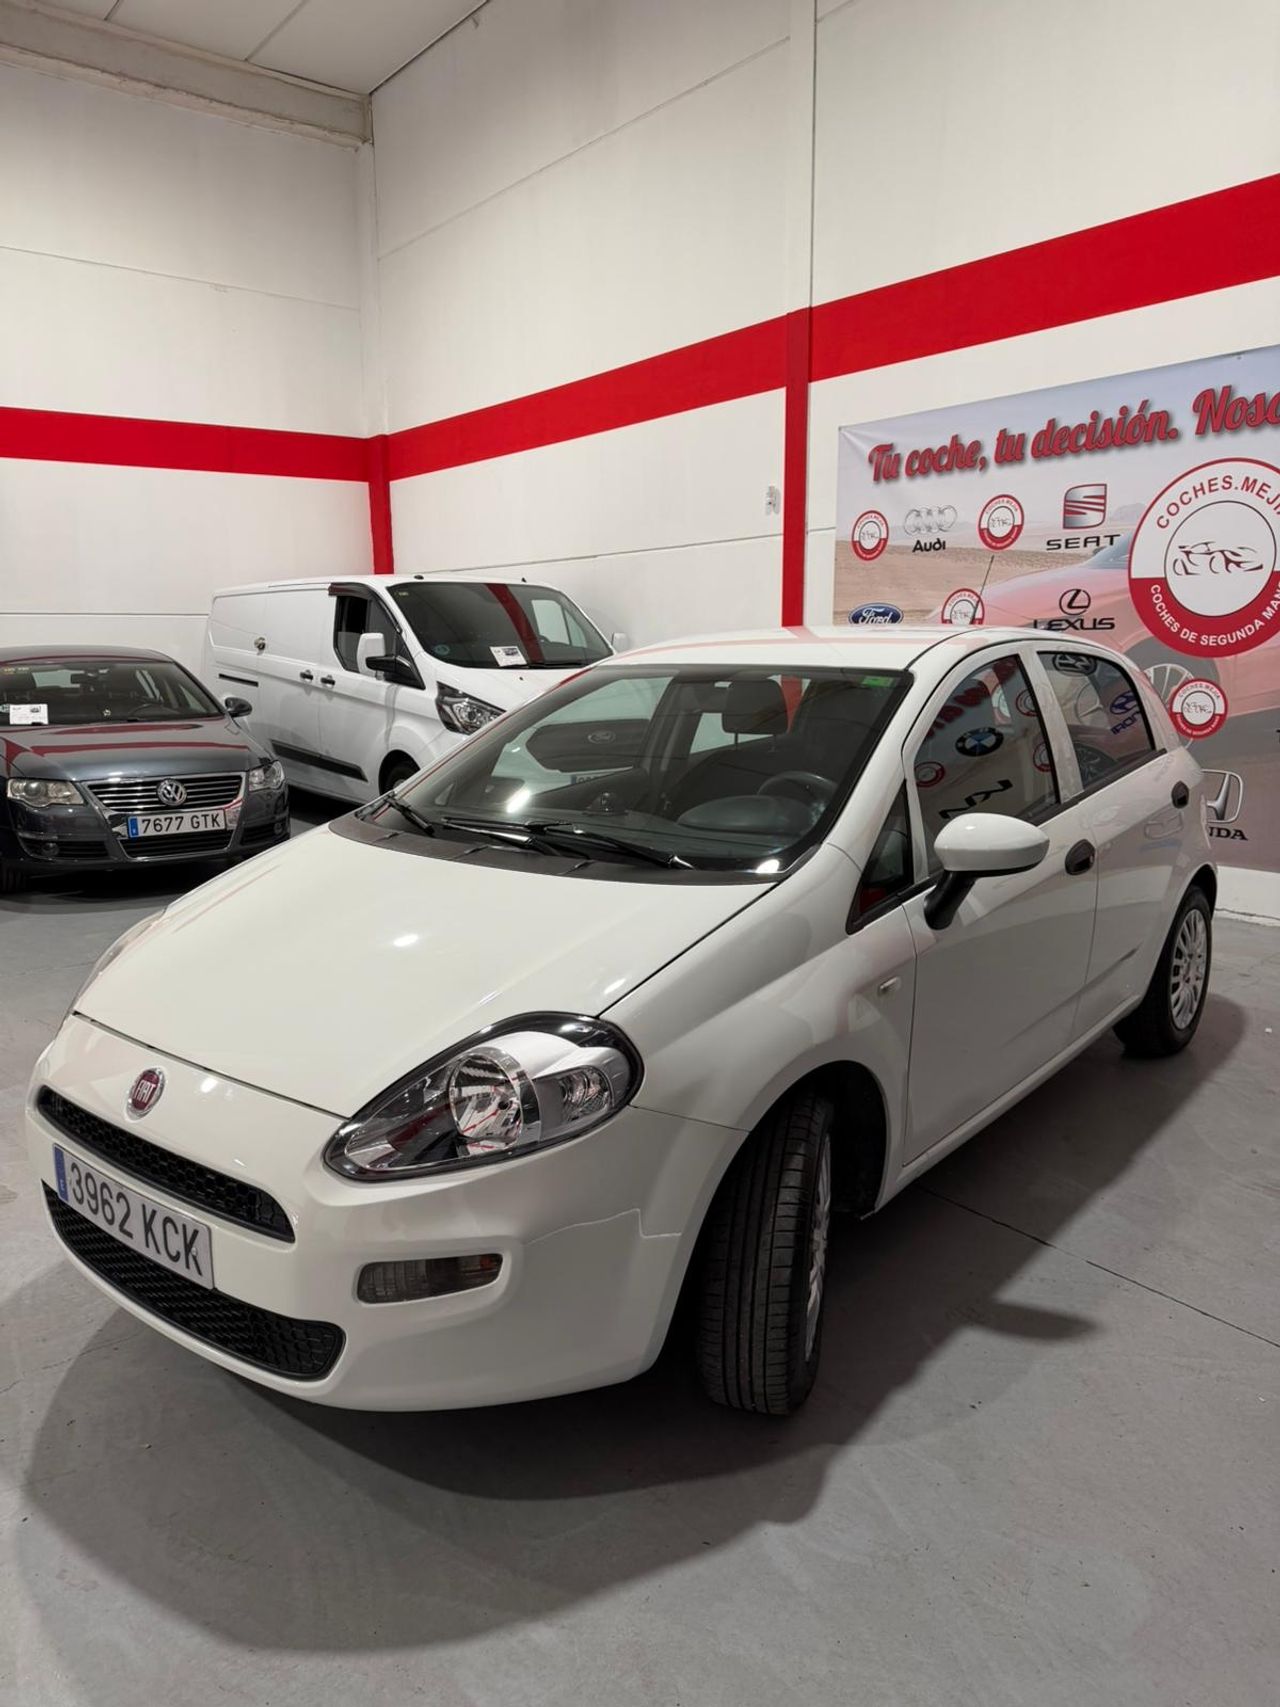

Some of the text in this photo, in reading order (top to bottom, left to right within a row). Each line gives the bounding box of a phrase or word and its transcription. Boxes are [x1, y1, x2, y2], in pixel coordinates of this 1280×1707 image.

[868, 443, 901, 481] Tu
[905, 434, 987, 477] coche,
[994, 428, 1026, 464] tu
[1031, 399, 1179, 459] decisión.
[912, 538, 946, 553] Audi
[1046, 534, 1121, 550] SEAT
[1151, 585, 1180, 632] COCHES
[1180, 628, 1198, 643] DE
[1200, 618, 1265, 646] SEGUNDA
[142, 812, 220, 834] 7677 GTK
[134, 1079, 156, 1104] FIAT
[70, 1162, 203, 1276] 3962 KCK
